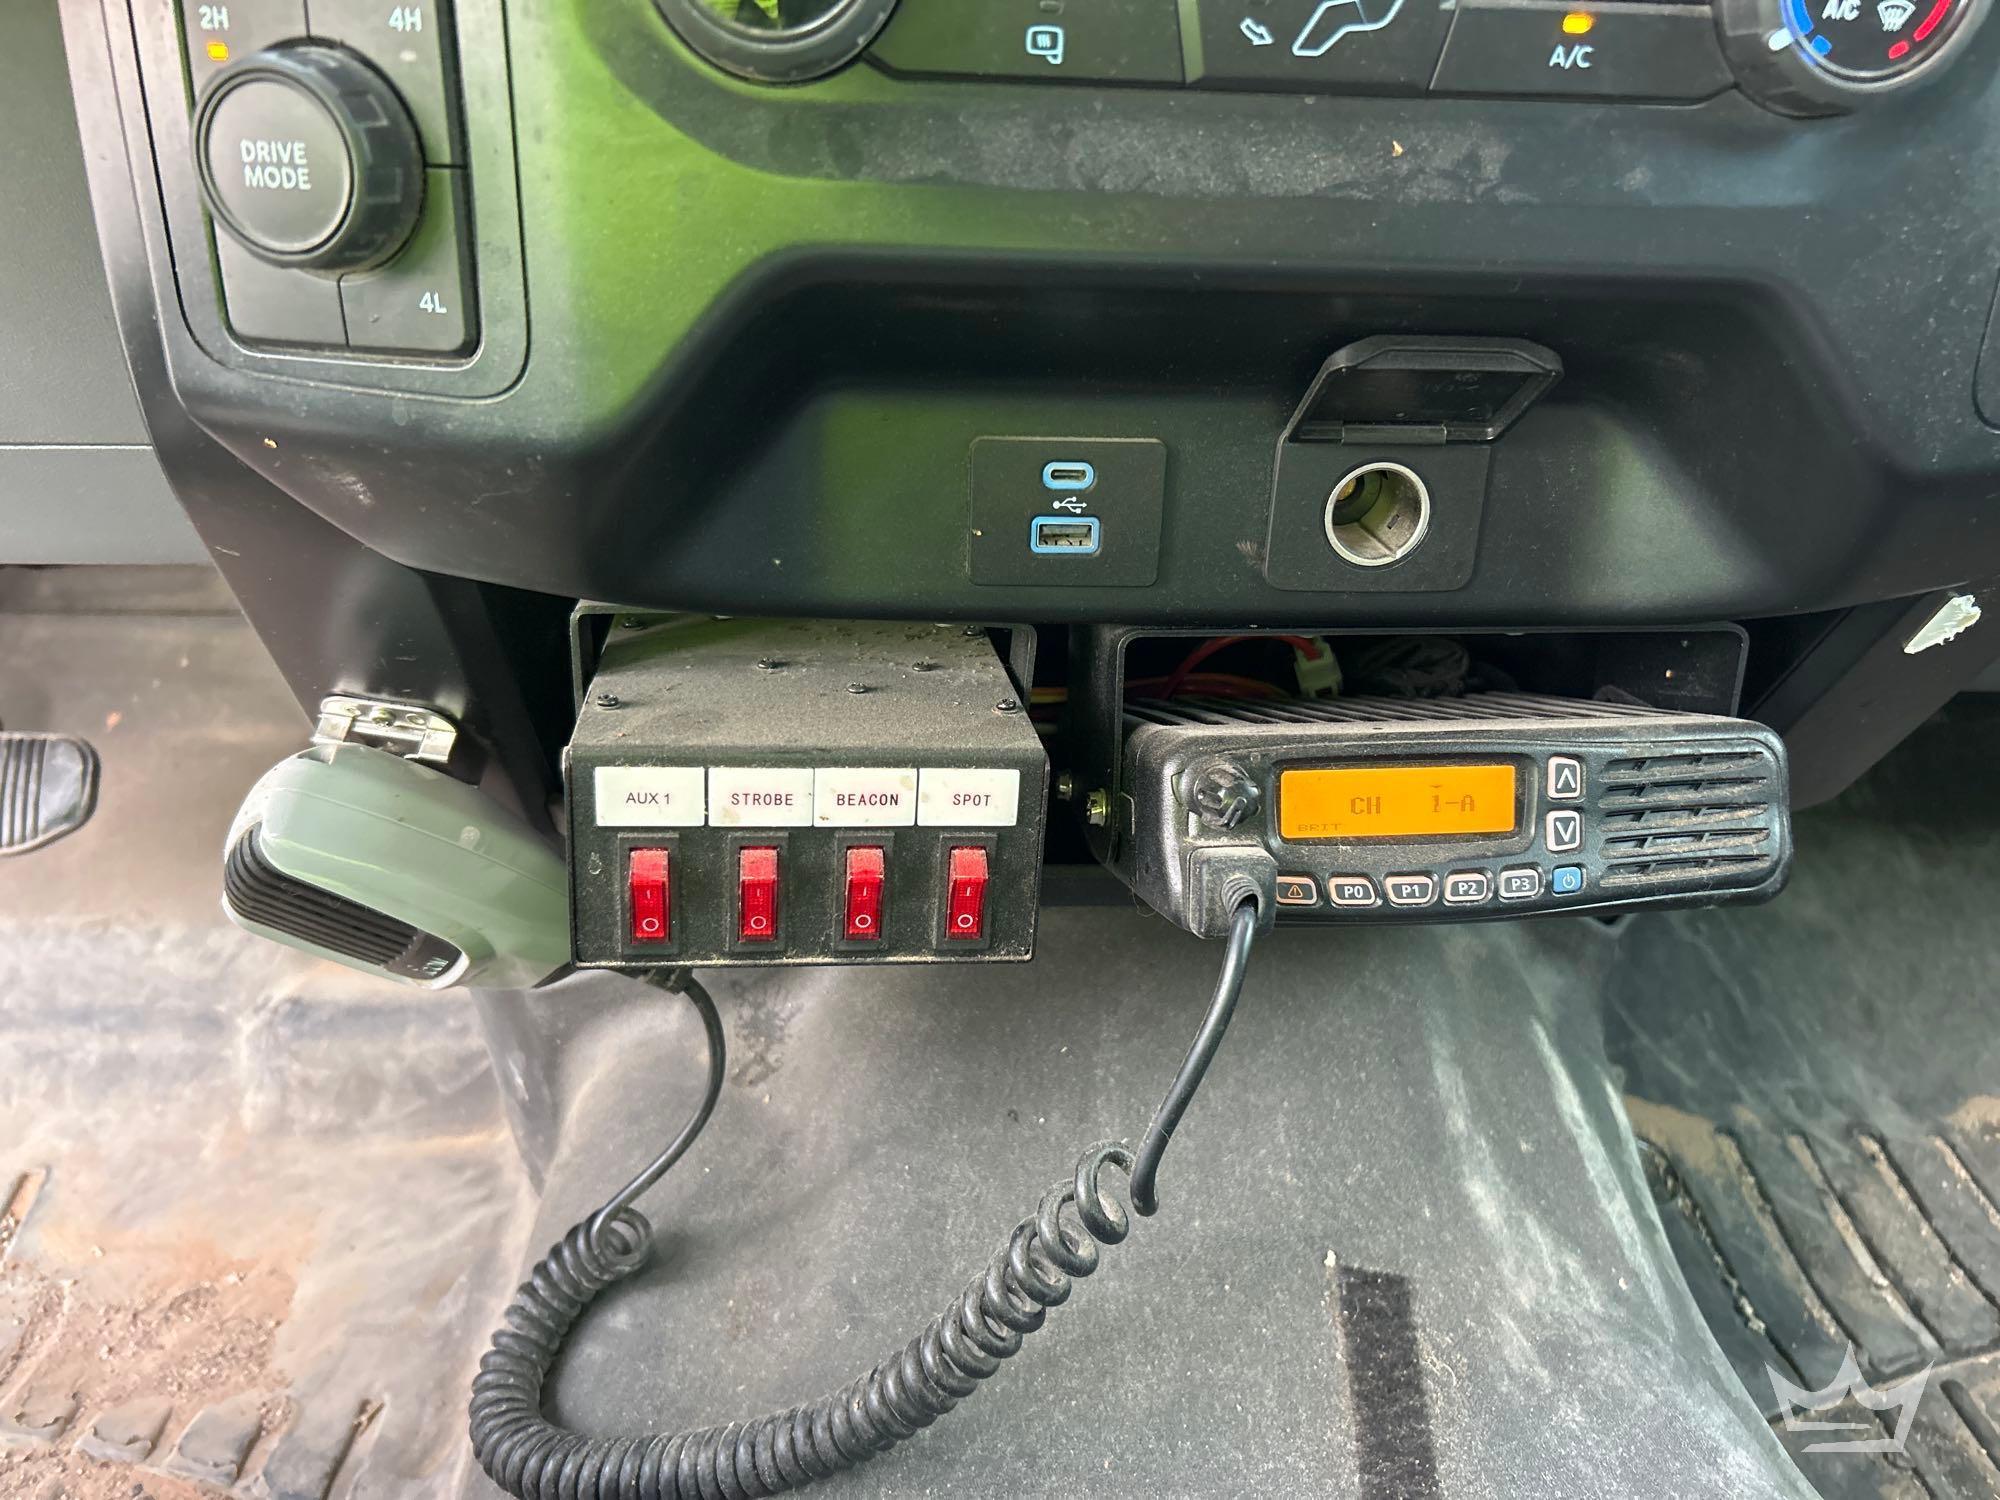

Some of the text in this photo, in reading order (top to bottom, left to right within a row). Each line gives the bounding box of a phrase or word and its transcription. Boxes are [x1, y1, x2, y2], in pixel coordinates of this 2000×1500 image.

[200, 7, 230, 31] 2H
[1821, 0, 1861, 21] A/C
[388, 8, 423, 33] 4H
[1549, 45, 1596, 70] A/C
[240, 139, 308, 165] DRIVE
[244, 166, 312, 191] MODE
[418, 291, 448, 314] 4L
[626, 792, 672, 805] AUX 1
[731, 793, 794, 806] STROBE
[836, 793, 899, 806] BEACON
[952, 793, 992, 807] SPOT
[1350, 796, 1382, 815] CH
[1401, 884, 1420, 898] P1
[1457, 881, 1478, 895] P2
[1511, 877, 1531, 891] P3
